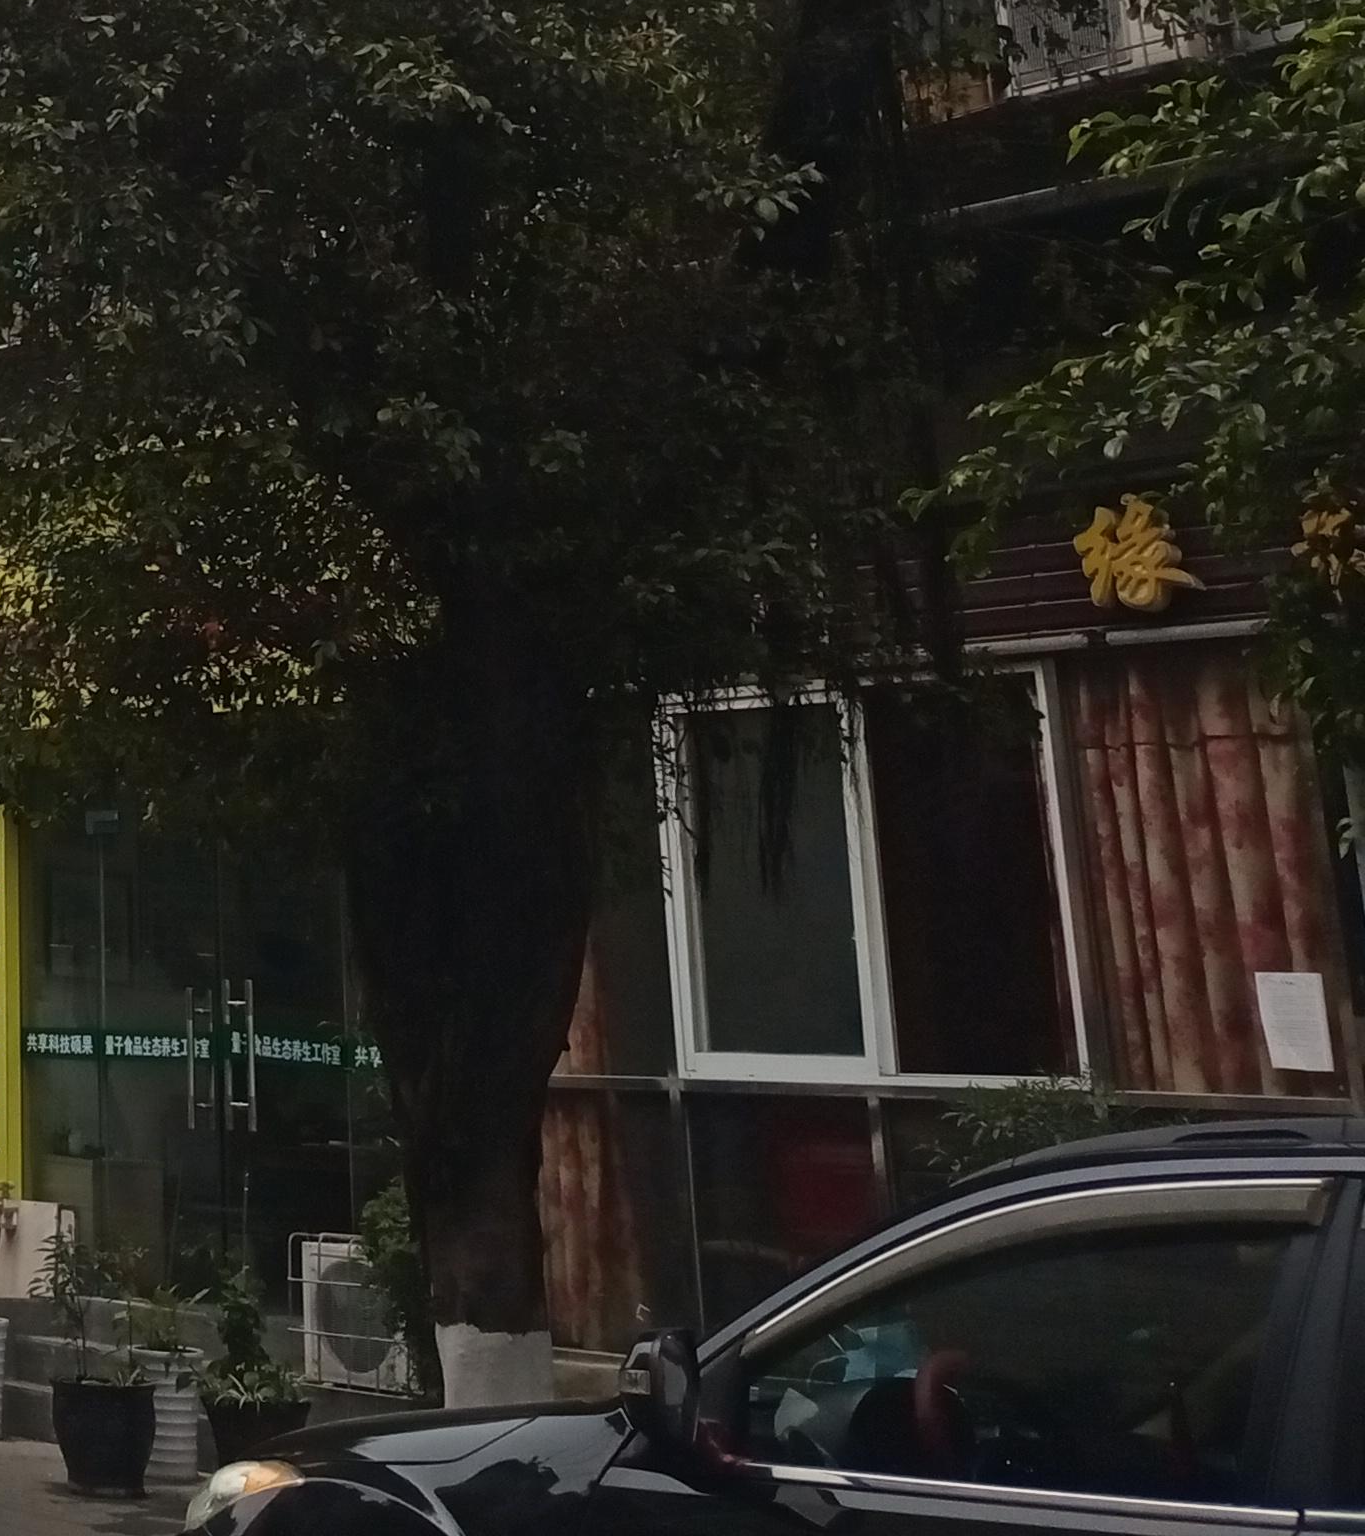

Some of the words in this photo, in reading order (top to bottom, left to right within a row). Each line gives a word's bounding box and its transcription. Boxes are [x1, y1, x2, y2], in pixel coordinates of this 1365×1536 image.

[27, 1033, 94, 1055] 共享科技硕果
